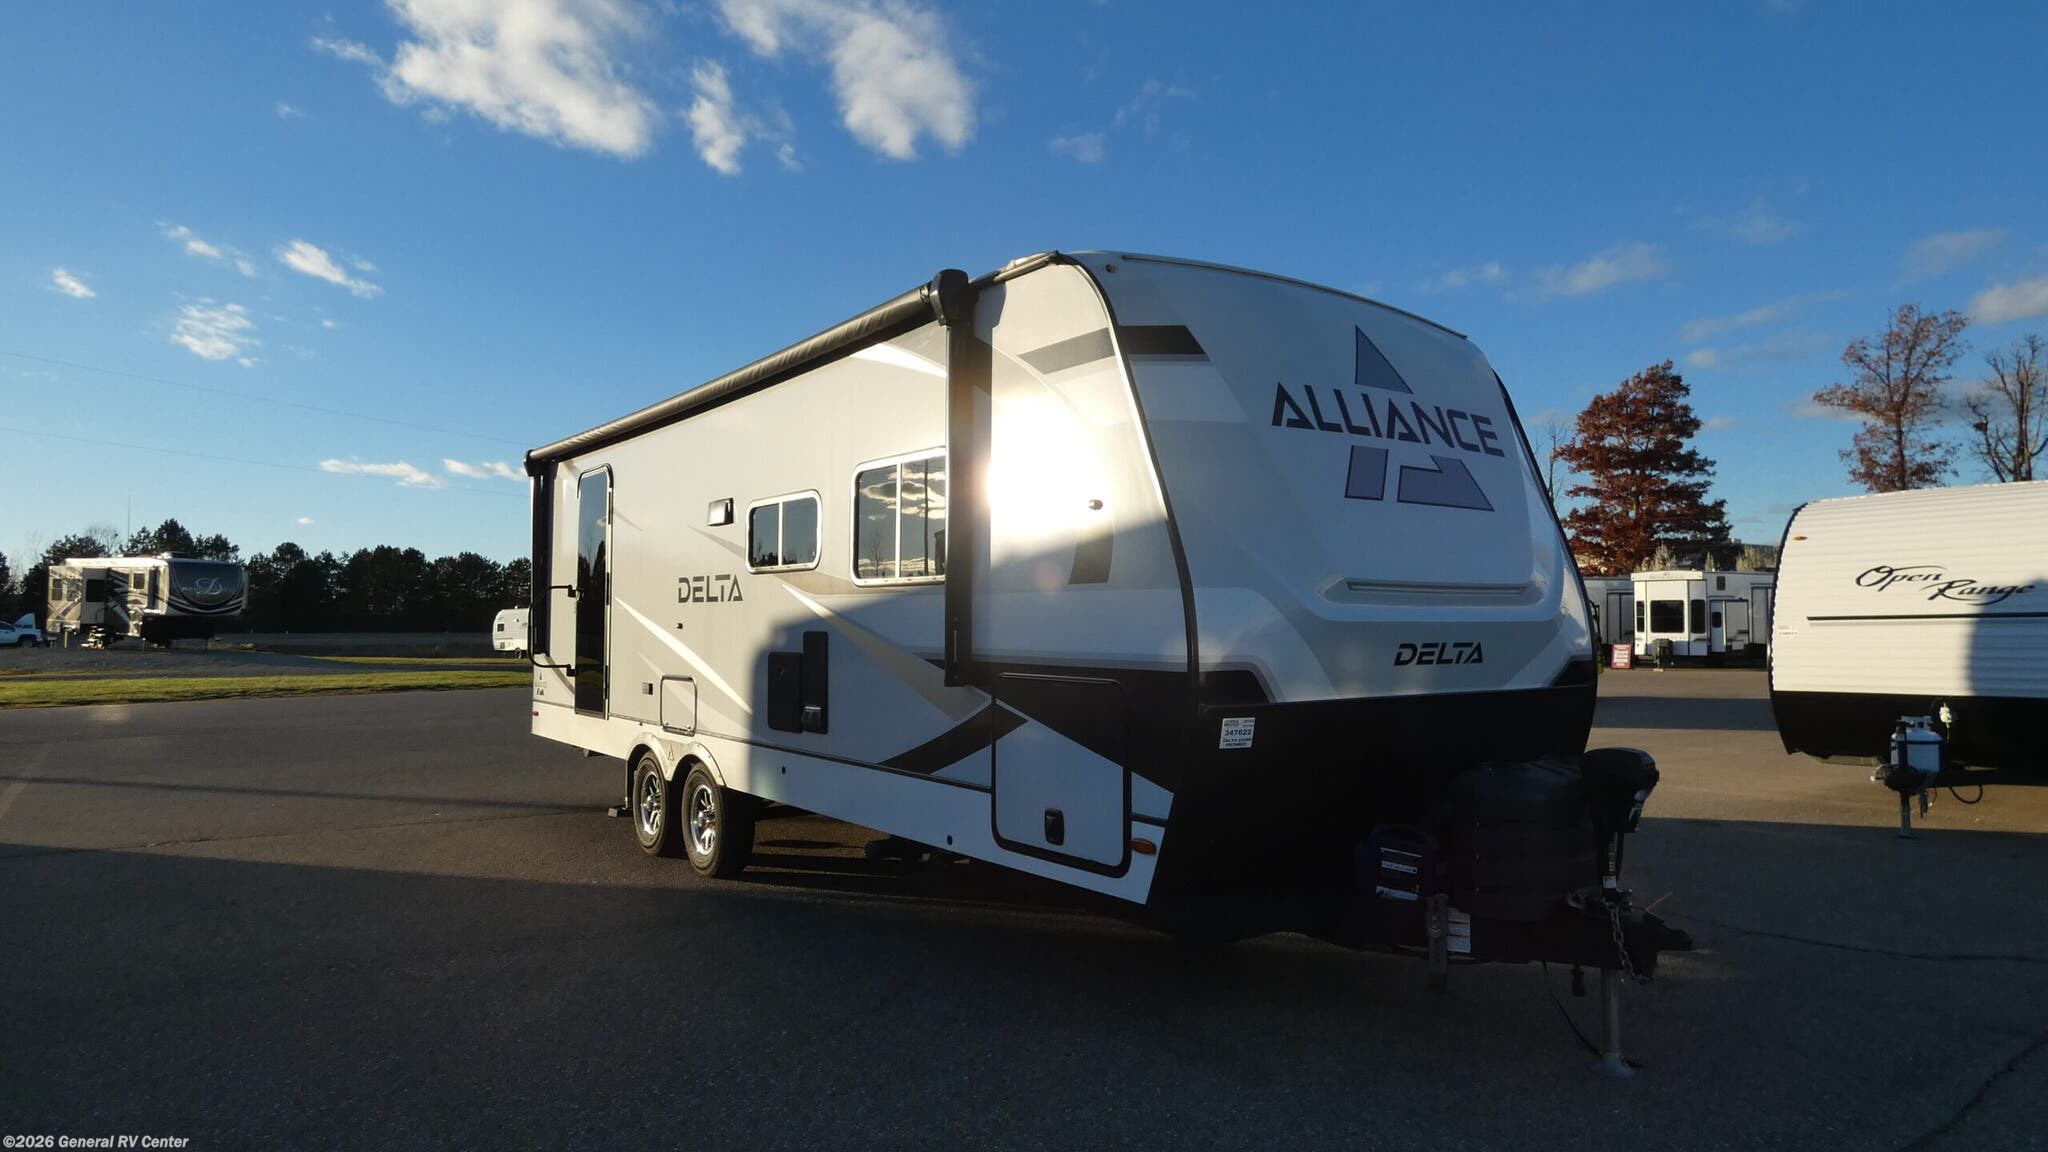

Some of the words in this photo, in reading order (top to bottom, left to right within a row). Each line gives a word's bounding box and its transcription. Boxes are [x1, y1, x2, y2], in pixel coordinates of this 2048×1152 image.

[1272, 382, 1505, 457] ALLIANCE
[678, 574, 743, 603] DELTA
[1855, 565, 1949, 593] Open
[1920, 579, 2035, 606] Range
[1393, 642, 1484, 666] DELTA
